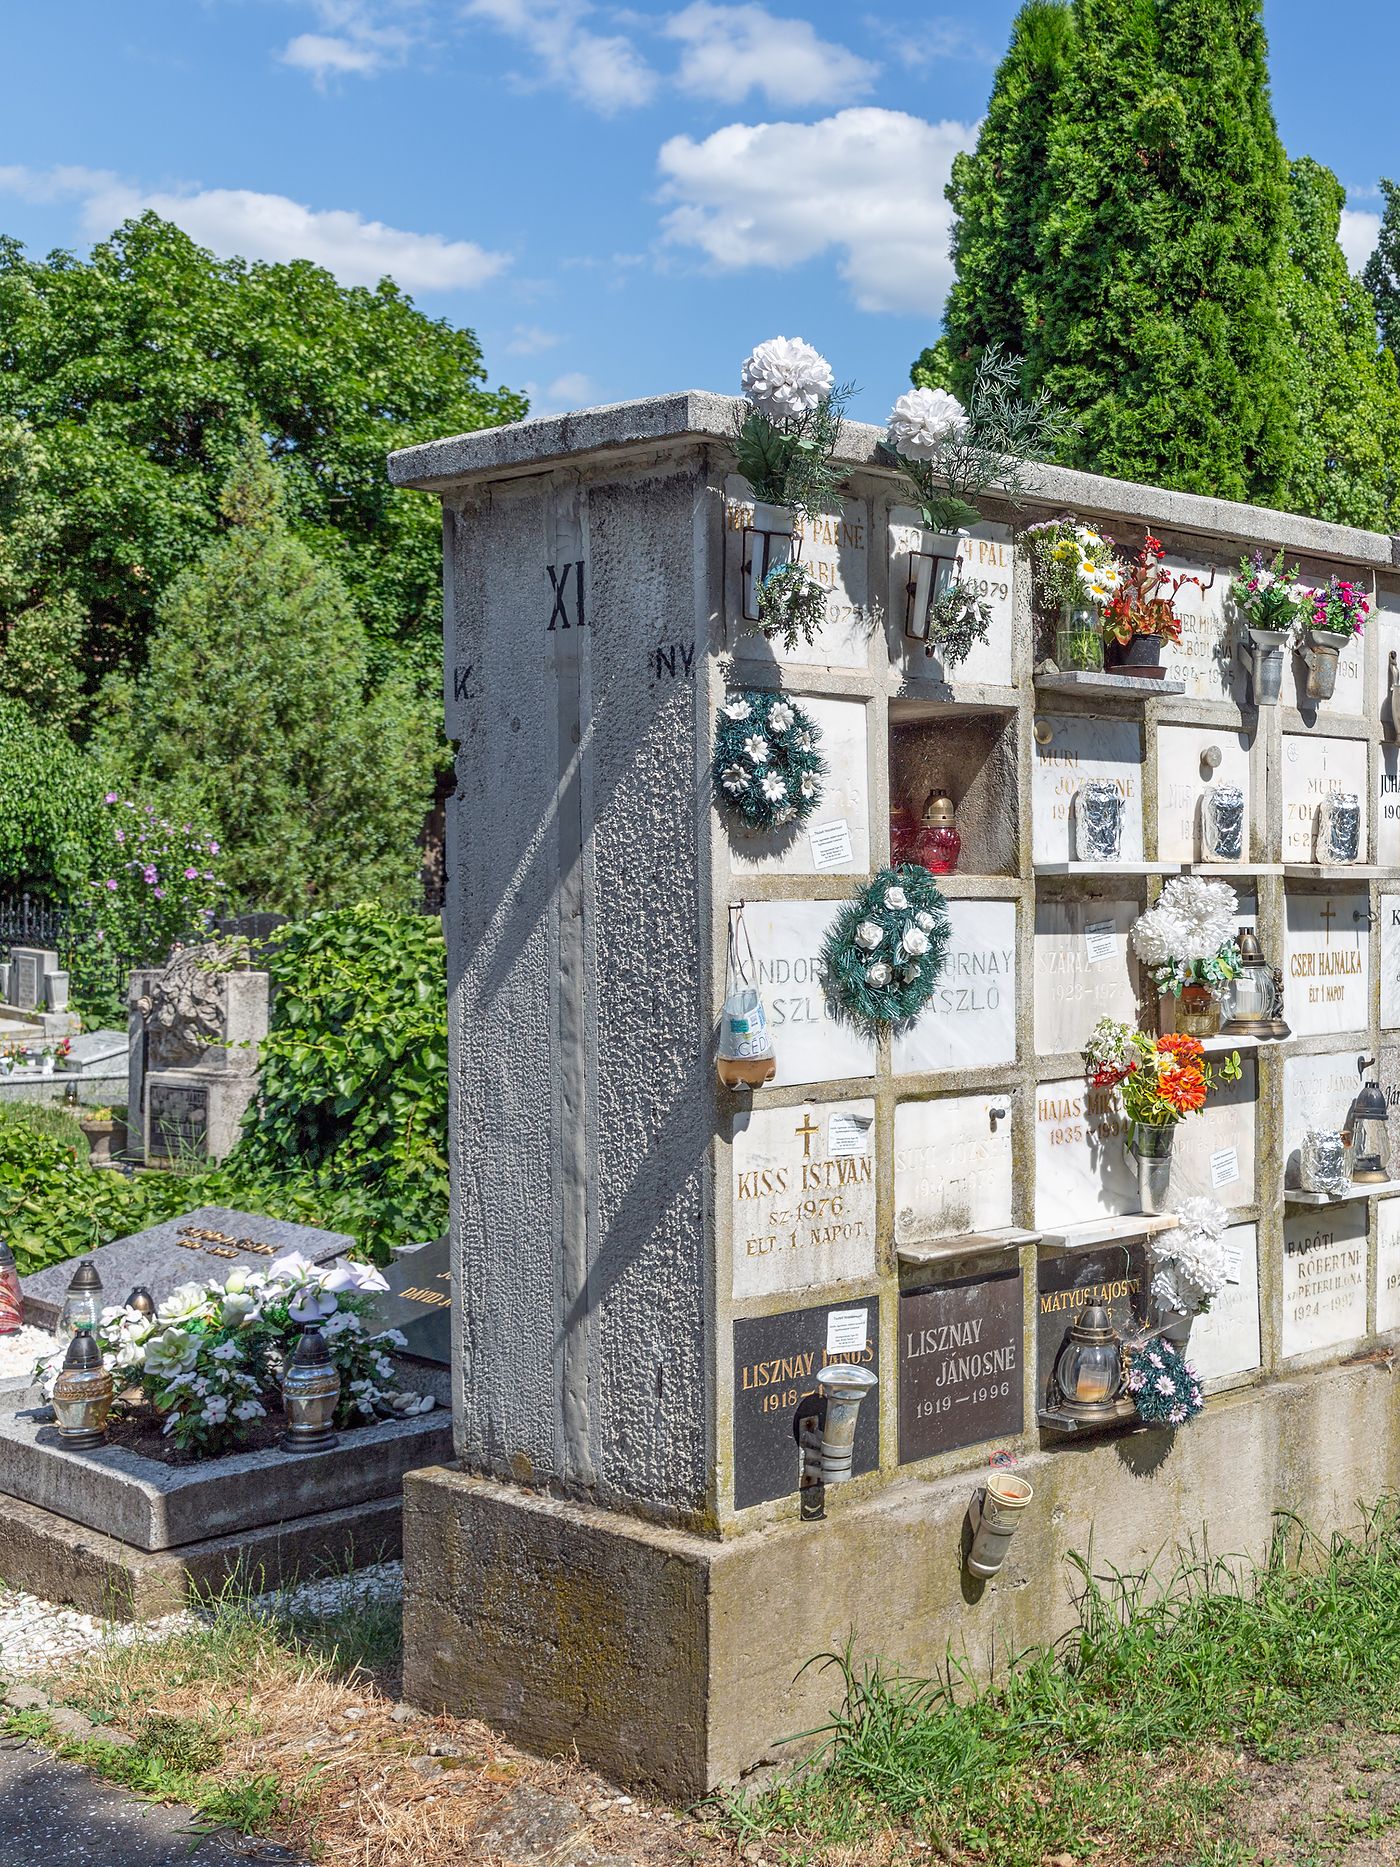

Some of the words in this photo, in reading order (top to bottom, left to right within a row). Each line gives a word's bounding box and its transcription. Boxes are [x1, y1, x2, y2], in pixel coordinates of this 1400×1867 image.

[547, 560, 585, 630] XI
[1039, 747, 1079, 769] MURI
[1291, 952, 1316, 978] CSERI
[1318, 948, 1362, 976] HAJNÁLKA
[1309, 984, 1319, 1002] ÉLT
[1038, 1097, 1081, 1122] HAJAS
[737, 1166, 789, 1201] KISS
[1288, 1230, 1334, 1259] BARÓTI
[1298, 1245, 1362, 1280] RÓBERTNÉ
[907, 1319, 983, 1359] LISZNAY
[742, 1351, 815, 1390] LISZNAY
[935, 1337, 1016, 1387] JÁNOSNÉ
